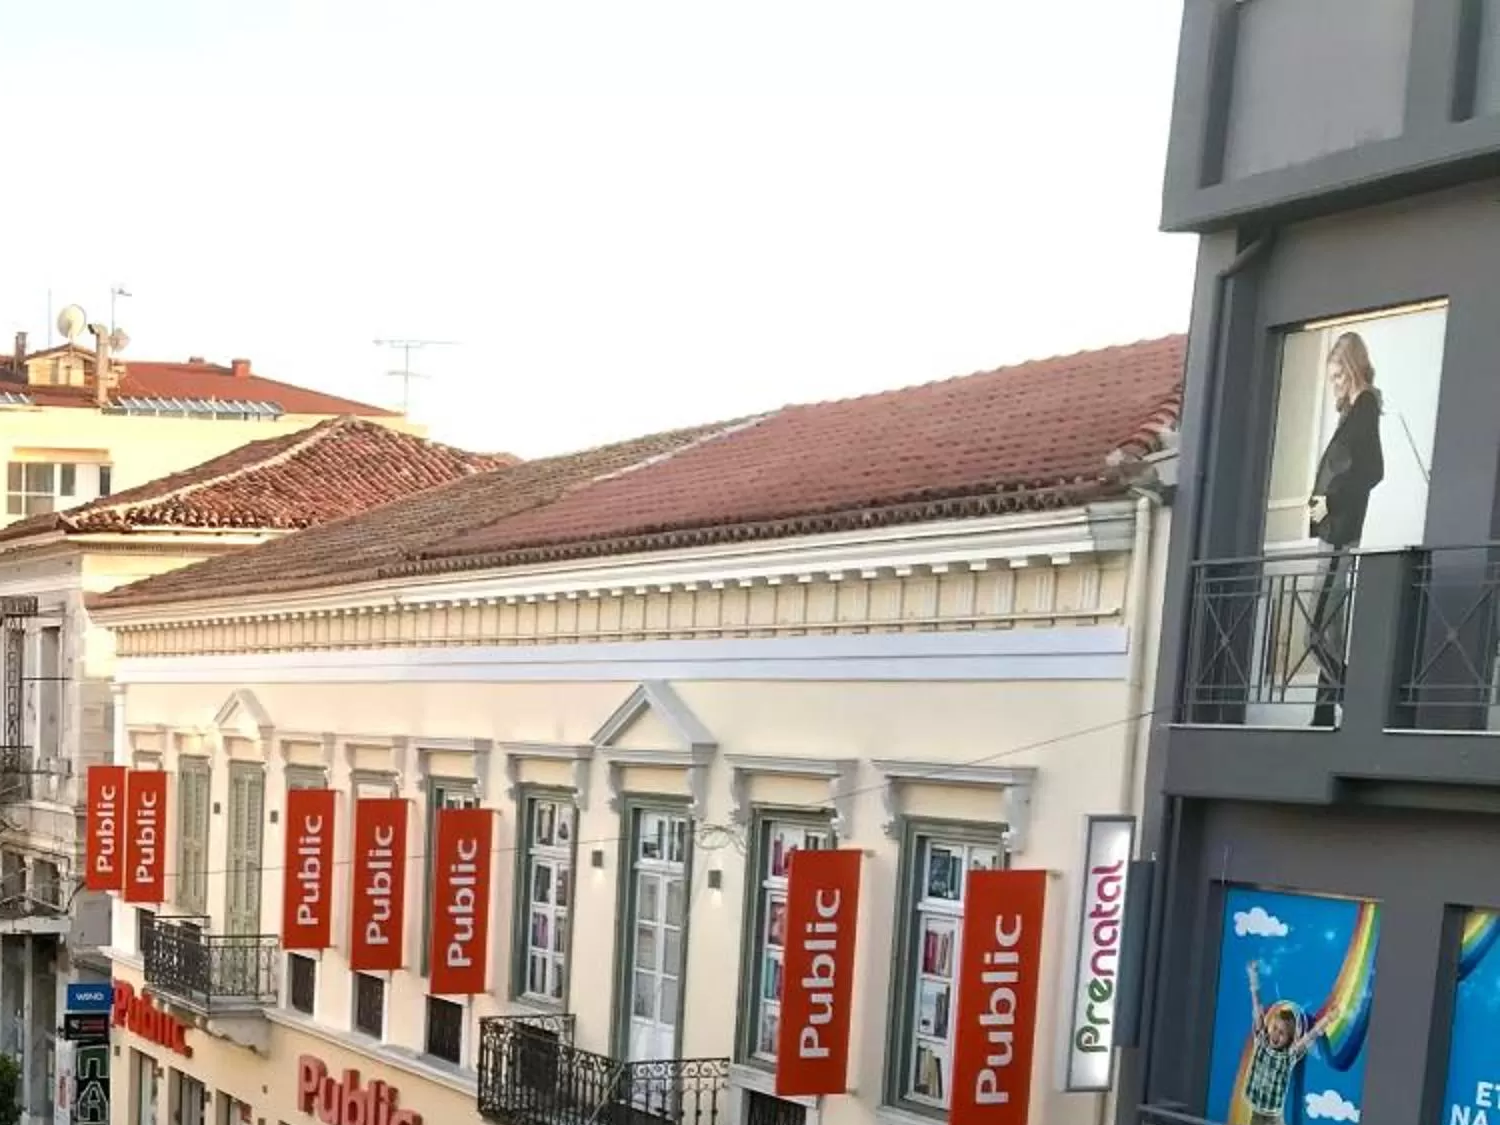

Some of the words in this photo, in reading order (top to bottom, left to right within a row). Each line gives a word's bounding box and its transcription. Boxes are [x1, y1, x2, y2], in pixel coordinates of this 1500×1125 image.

[96, 785, 116, 872] Public
[136, 791, 157, 883] Public
[297, 815, 323, 925] Public
[365, 825, 393, 945] Public
[447, 839, 477, 967] Public
[1075, 859, 1124, 1053] Prenatal
[799, 888, 841, 1058] Public
[975, 913, 1022, 1105] Public
